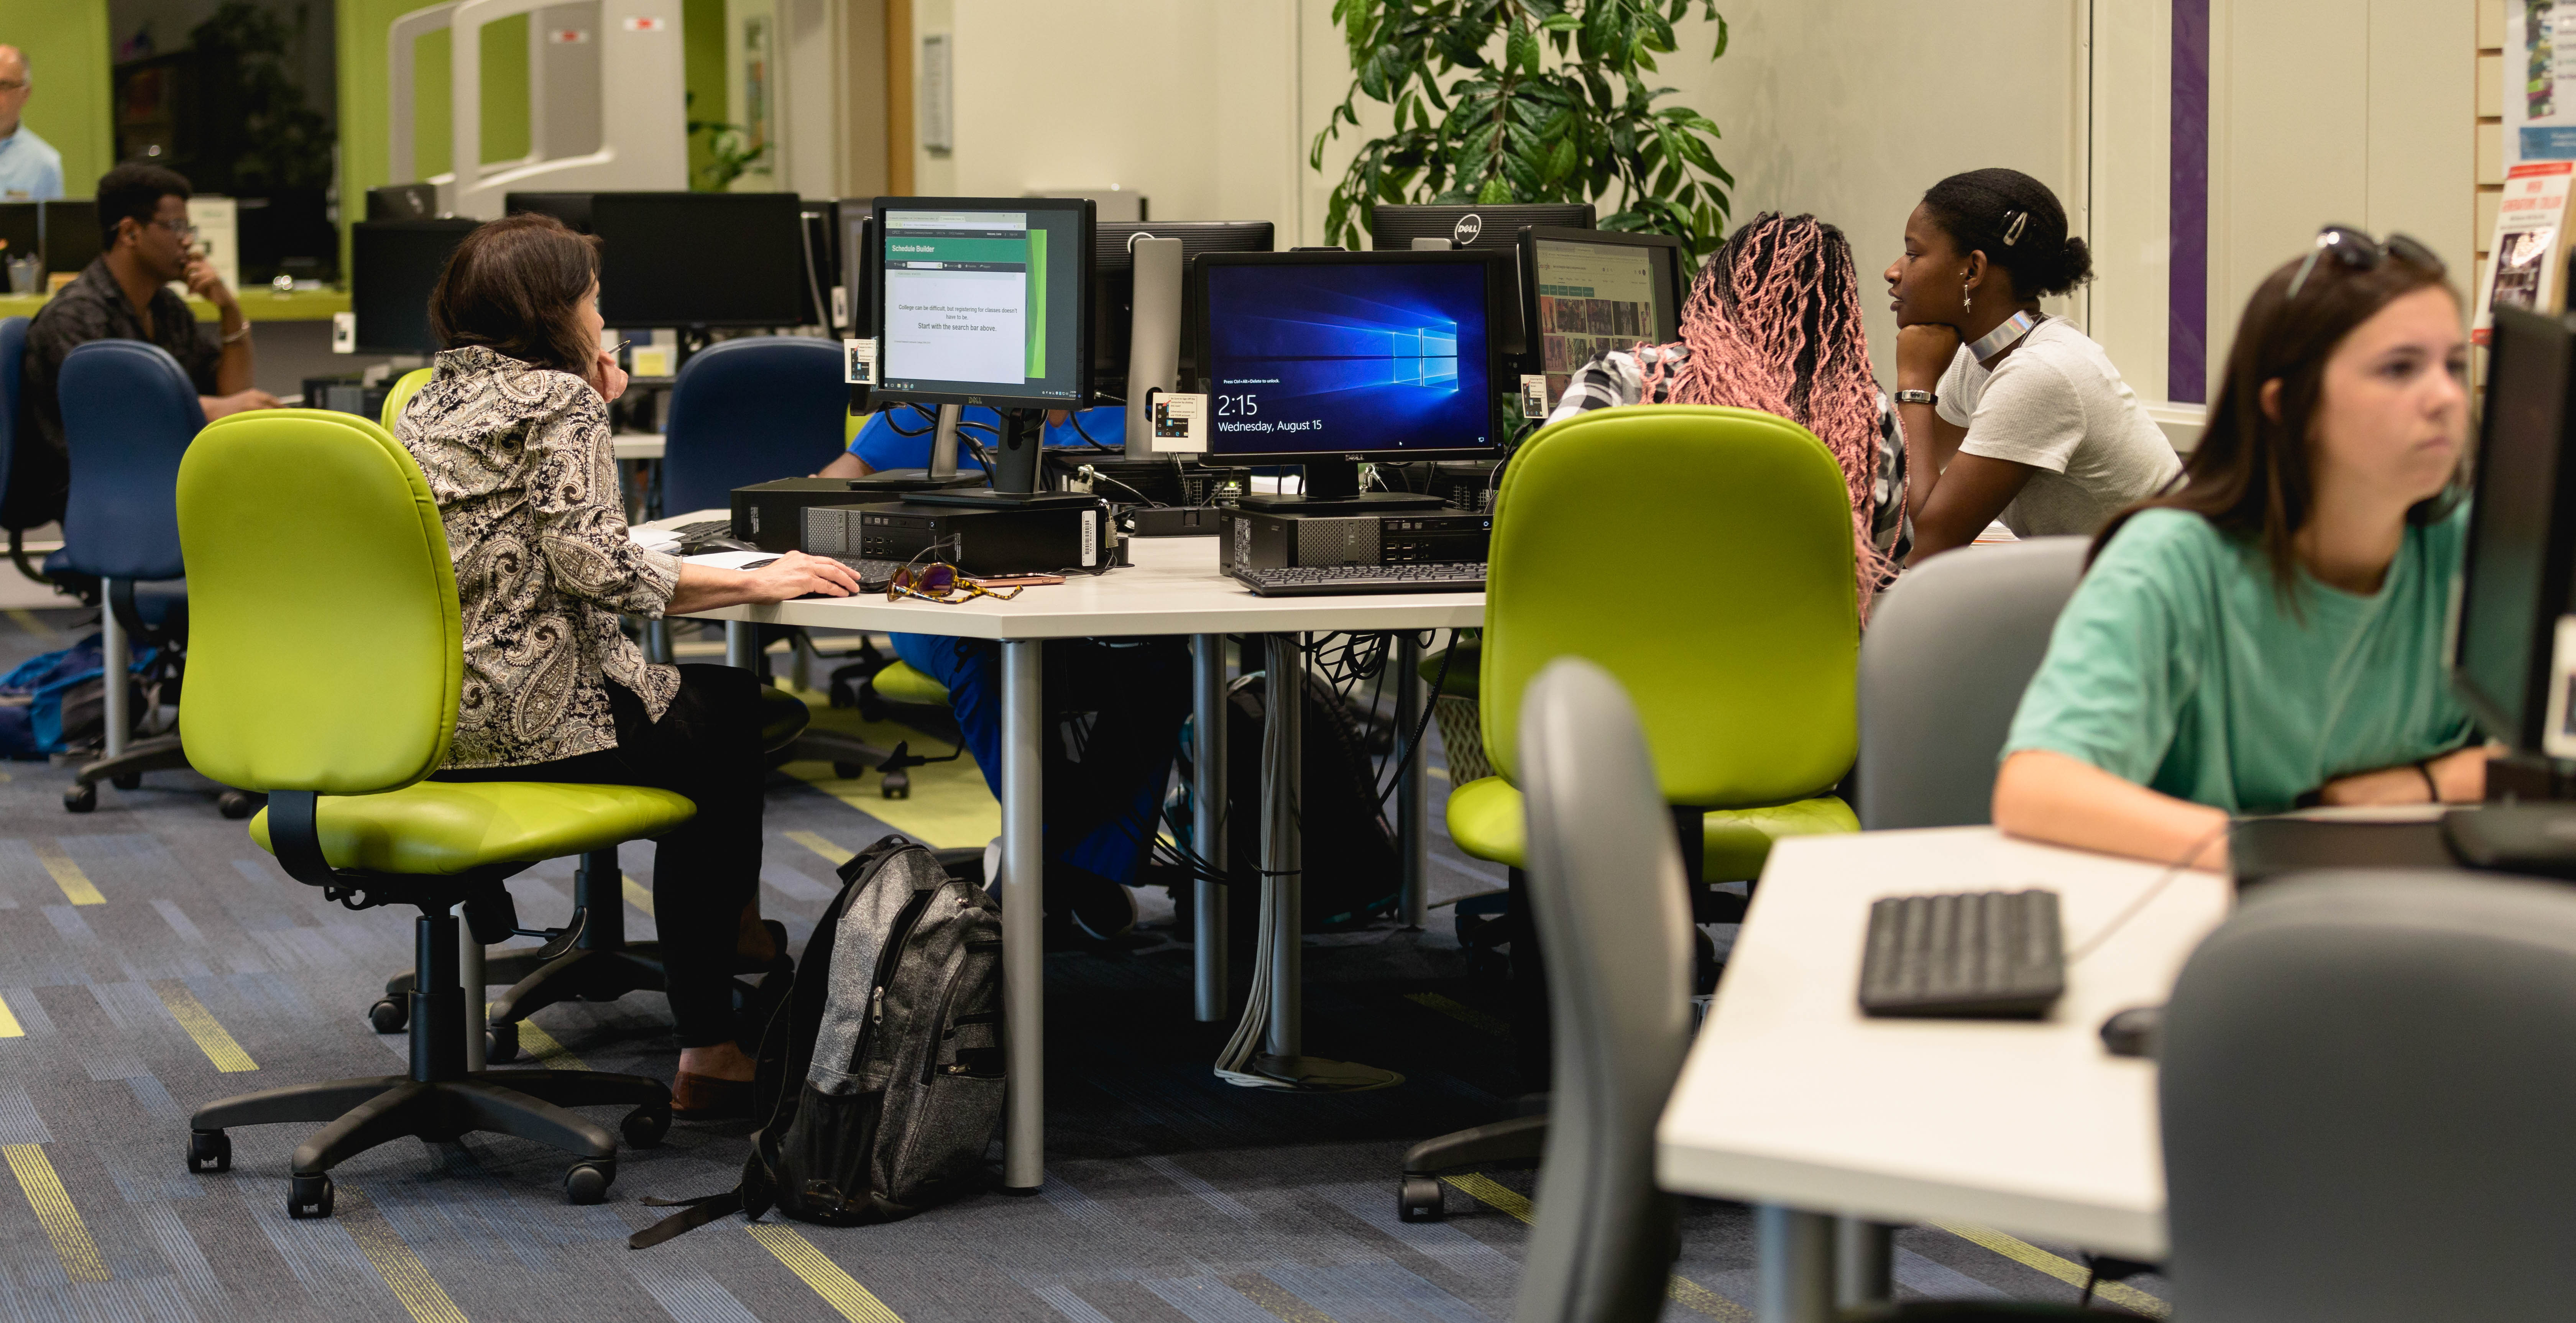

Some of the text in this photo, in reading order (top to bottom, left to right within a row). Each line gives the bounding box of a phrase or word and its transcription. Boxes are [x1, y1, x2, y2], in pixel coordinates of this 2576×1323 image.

[1457, 225, 1477, 233] DELL
[1218, 395, 1257, 416] 2:15
[1218, 420, 1322, 433] Wednesday, August 15
